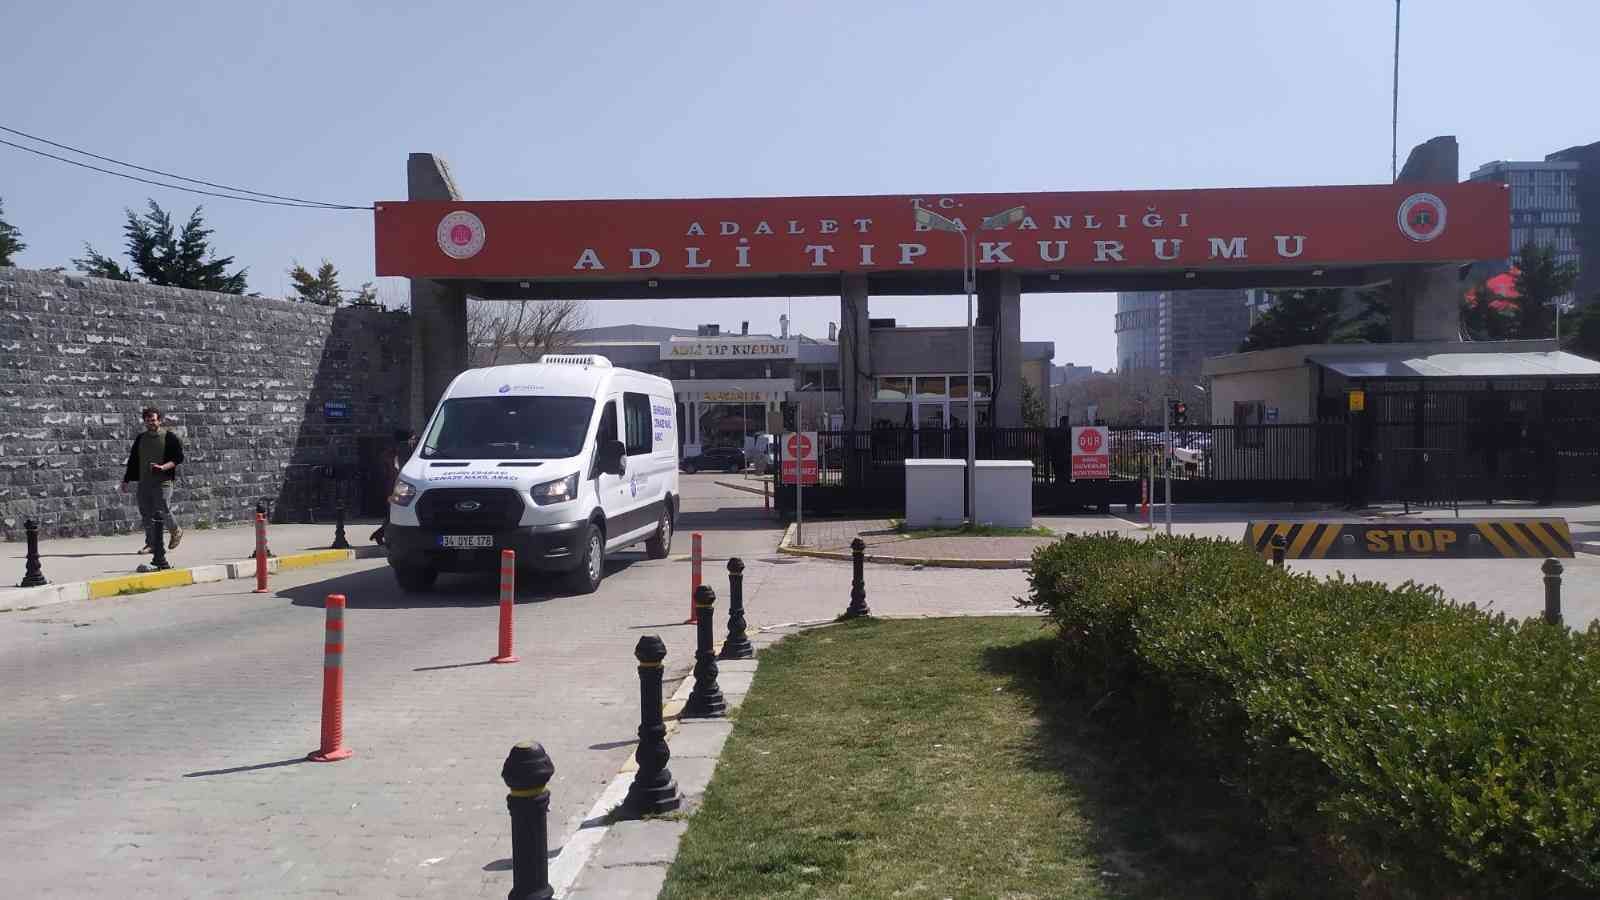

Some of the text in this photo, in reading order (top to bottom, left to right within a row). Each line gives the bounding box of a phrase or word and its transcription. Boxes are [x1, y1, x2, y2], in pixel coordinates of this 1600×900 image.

[687, 219, 873, 236] ADALET
[573, 235, 1308, 271] ADLİ TIP KURUMU
[707, 344, 729, 355] TIP
[1366, 529, 1457, 554] STOP
